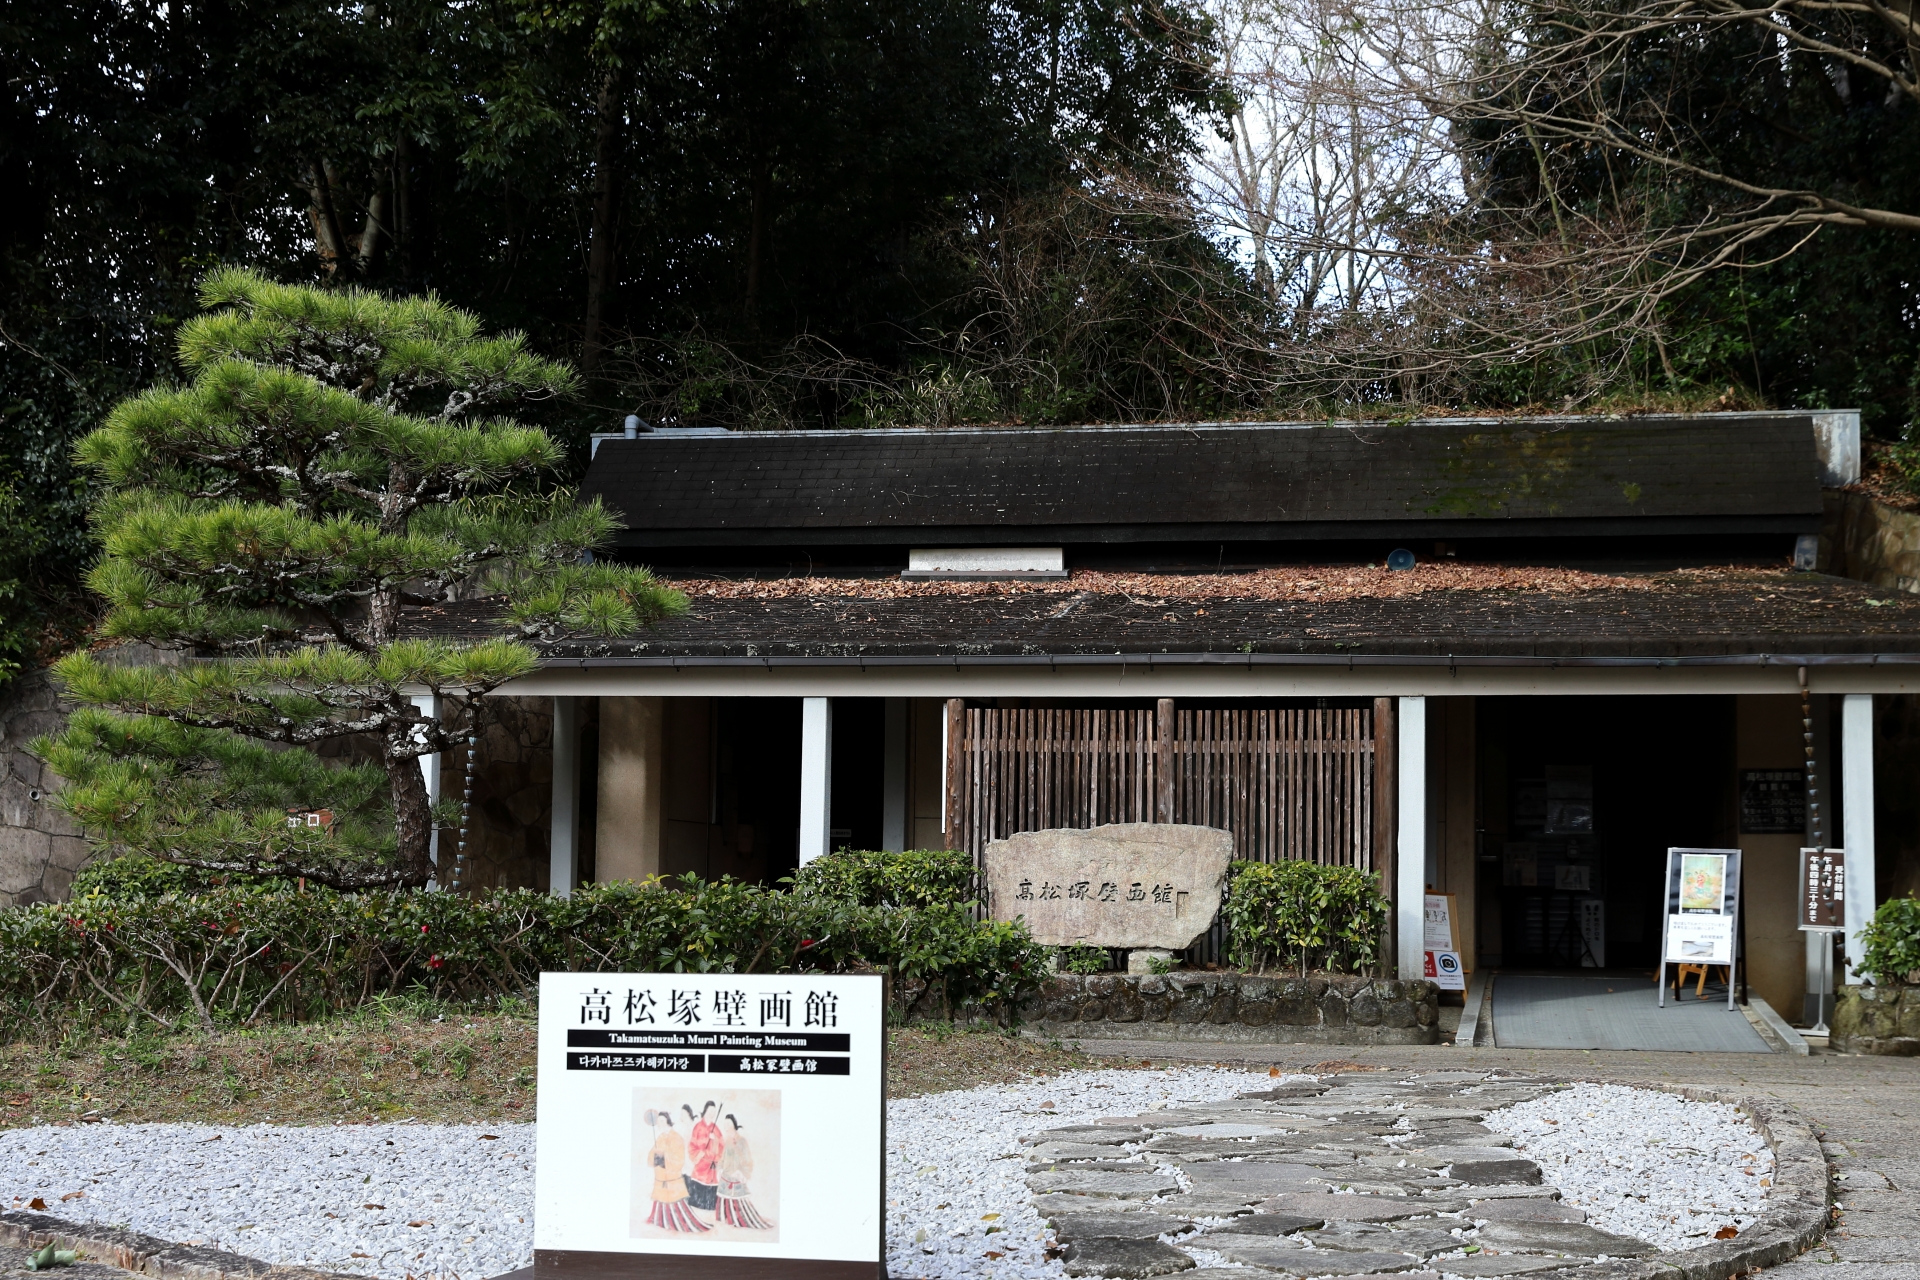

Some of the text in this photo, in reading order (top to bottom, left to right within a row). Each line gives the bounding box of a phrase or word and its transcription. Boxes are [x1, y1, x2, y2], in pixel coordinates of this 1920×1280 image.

[1808, 856, 1820, 922] 午後四時三十分まで
[1833, 865, 1844, 901] 受付時間
[579, 987, 839, 1028] 高松塚壁画館
[608, 1033, 807, 1048] Takamatsuzuka Mural Painting Museum
